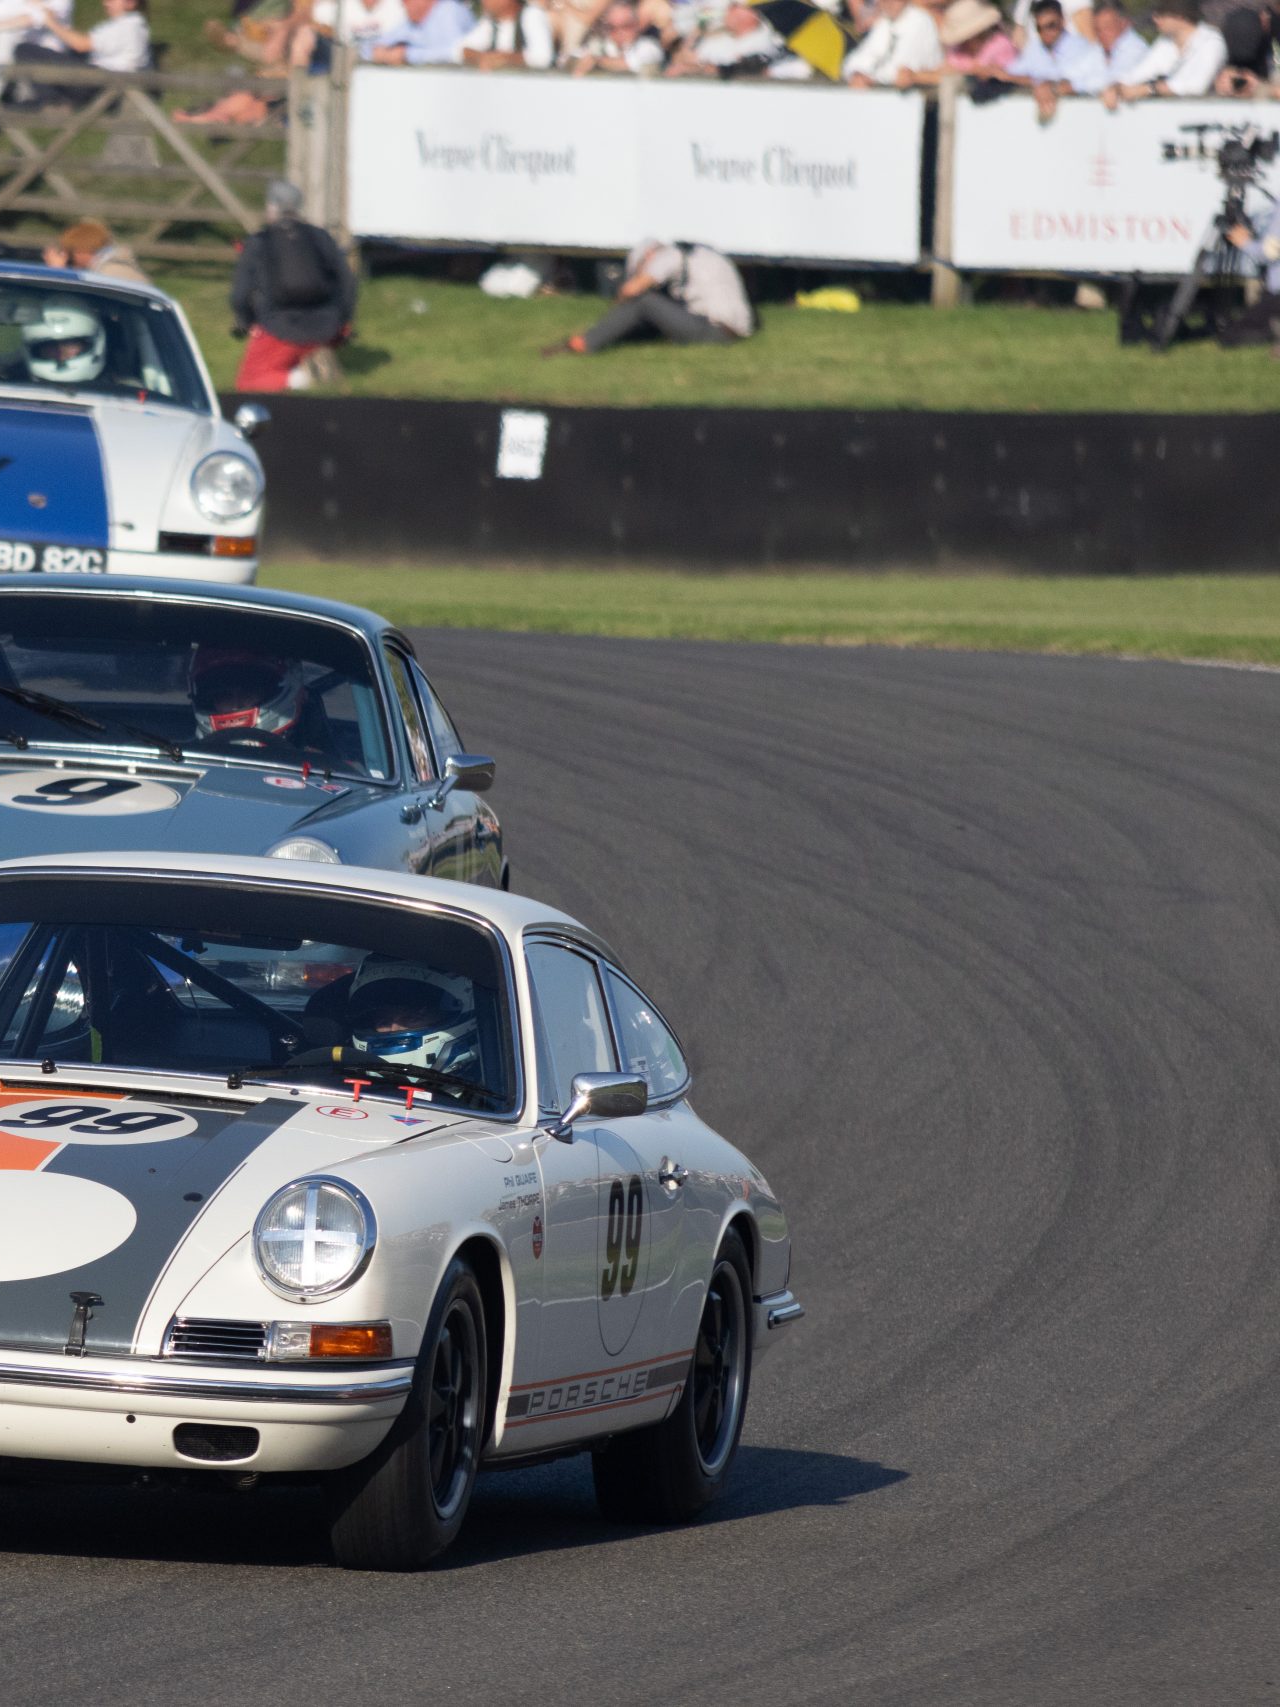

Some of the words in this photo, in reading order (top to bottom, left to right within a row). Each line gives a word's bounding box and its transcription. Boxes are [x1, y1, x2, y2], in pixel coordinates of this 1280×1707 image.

[1009, 209, 1192, 244] EDMISTON
[42, 545, 103, 575] 82C
[10, 777, 143, 807] 9
[330, 1106, 356, 1118] E
[601, 1174, 643, 1302] 99
[528, 1370, 648, 1415] PORSCHE
